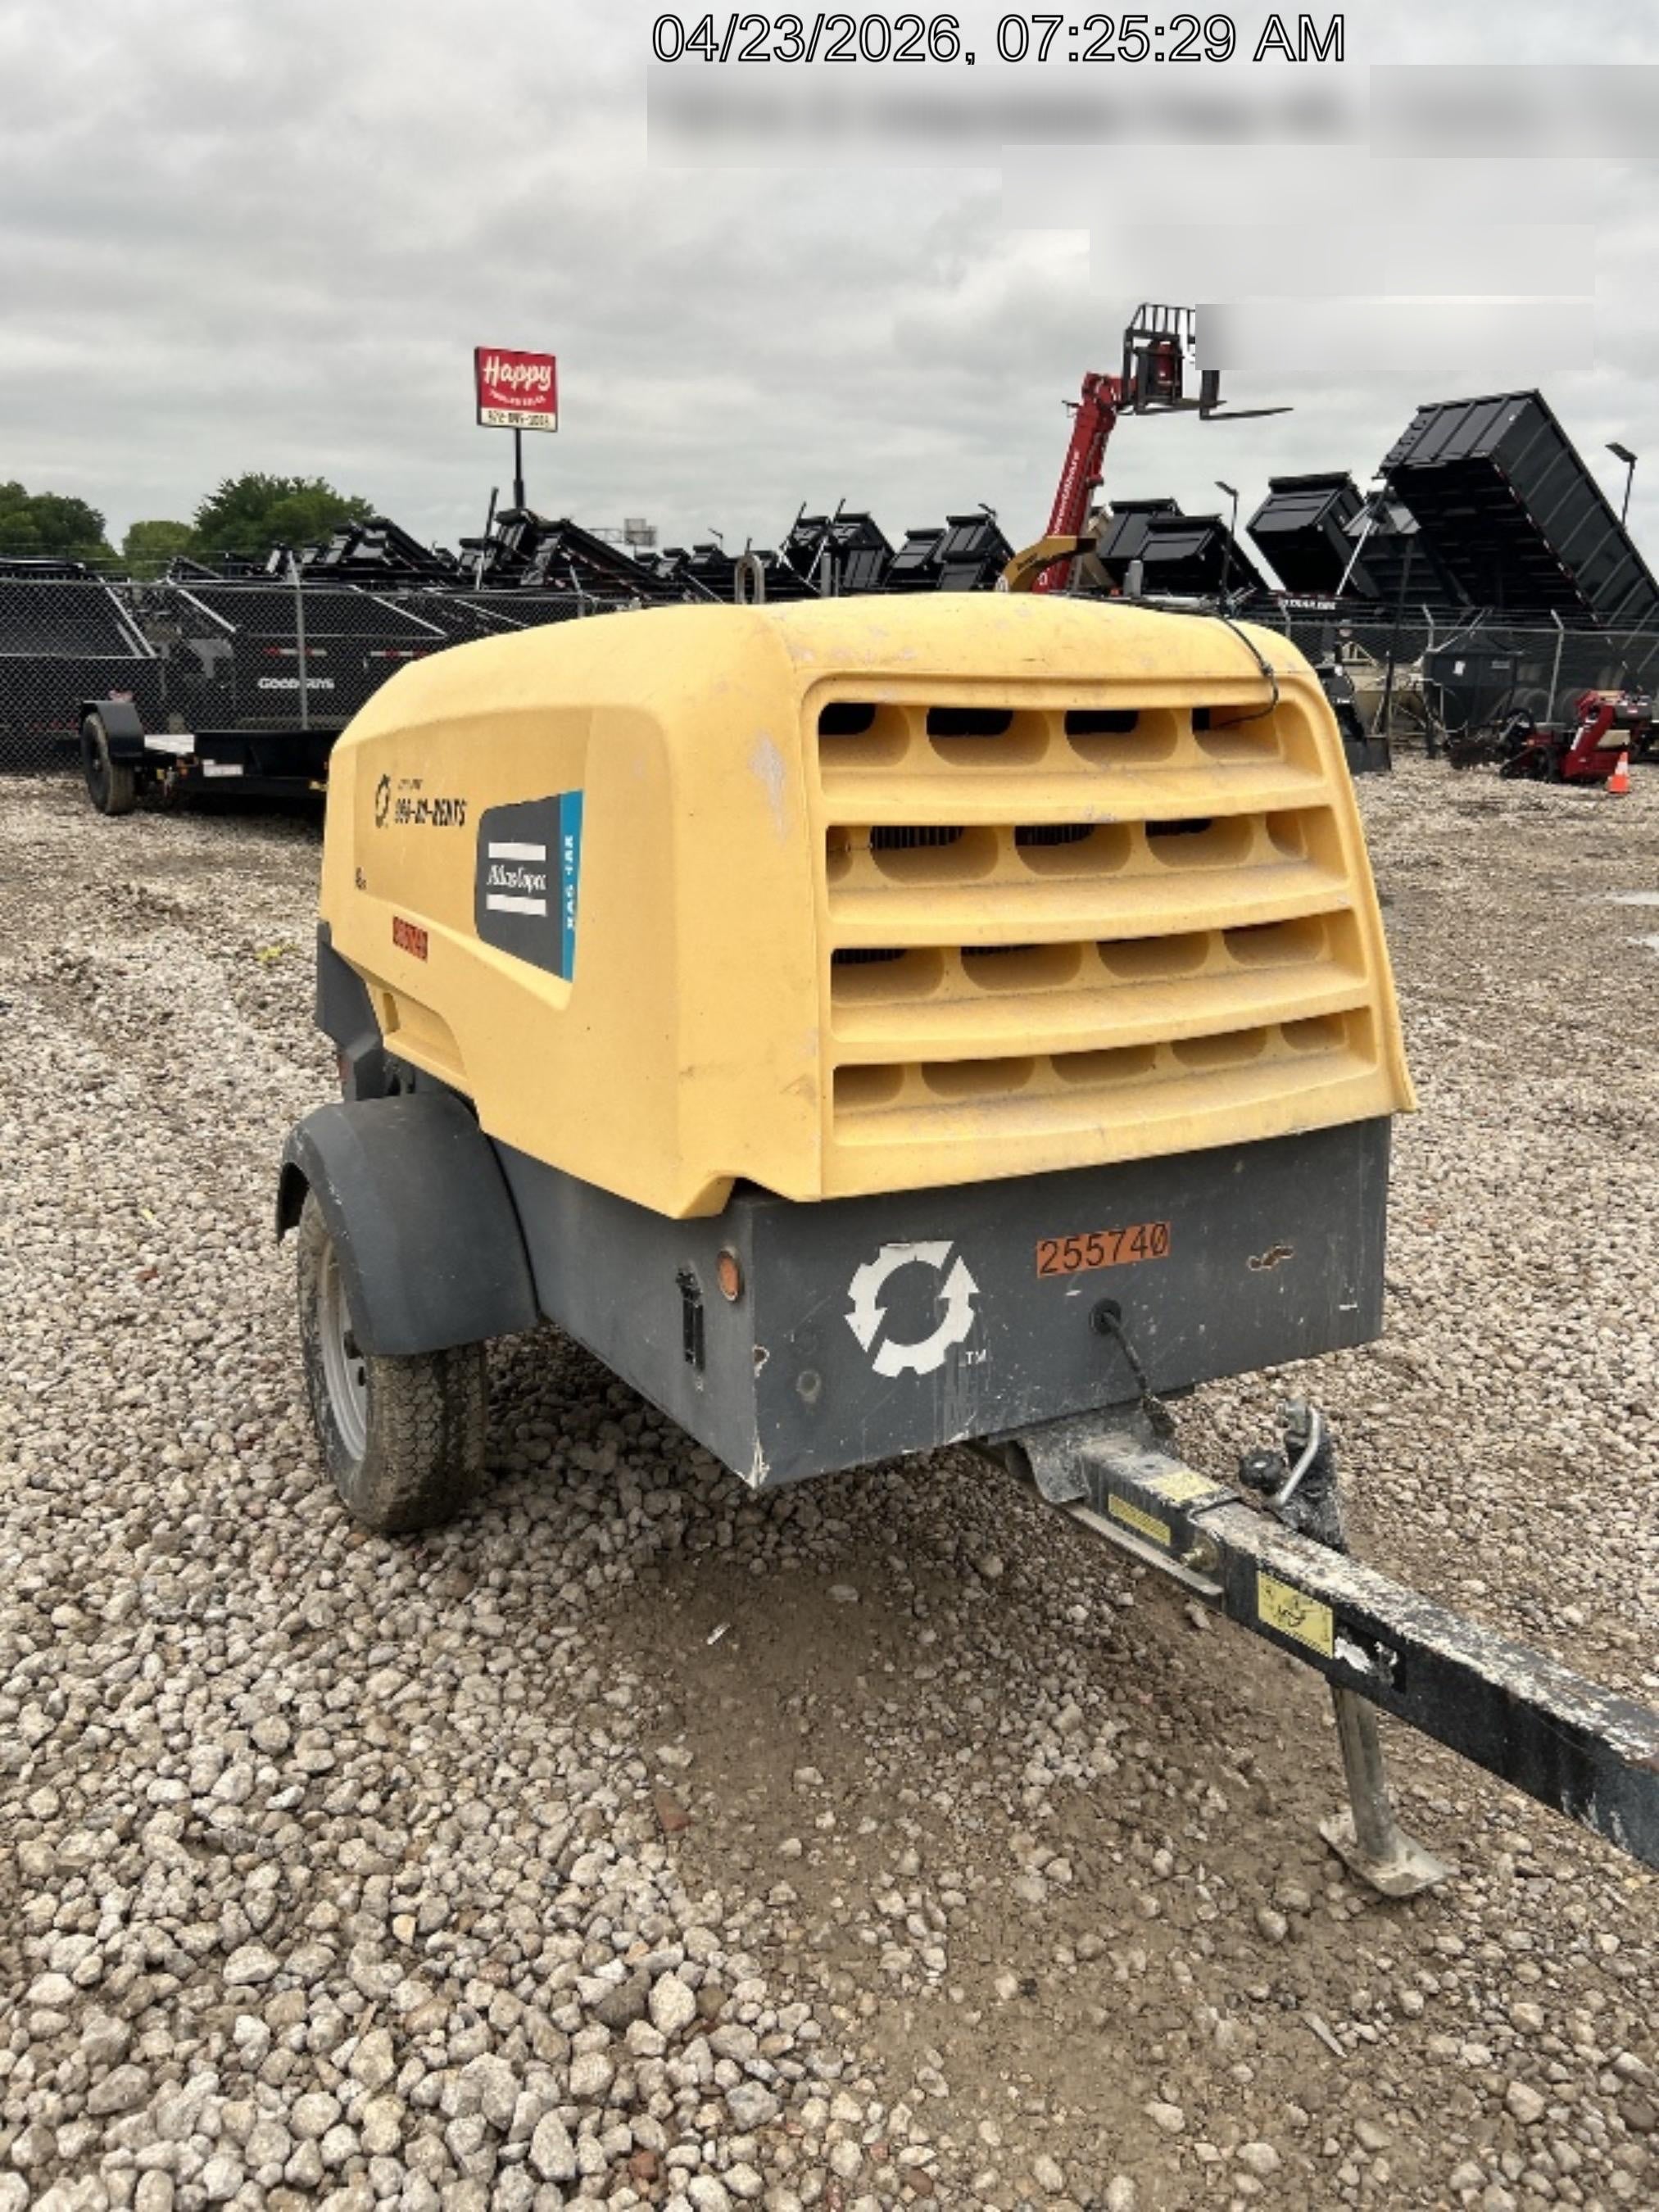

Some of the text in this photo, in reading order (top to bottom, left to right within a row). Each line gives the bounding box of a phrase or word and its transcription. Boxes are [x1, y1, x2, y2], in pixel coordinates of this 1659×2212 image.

[483, 356, 551, 392] Happy
[257, 677, 301, 689] GOOD
[1040, 1223, 1168, 1274] 255740
